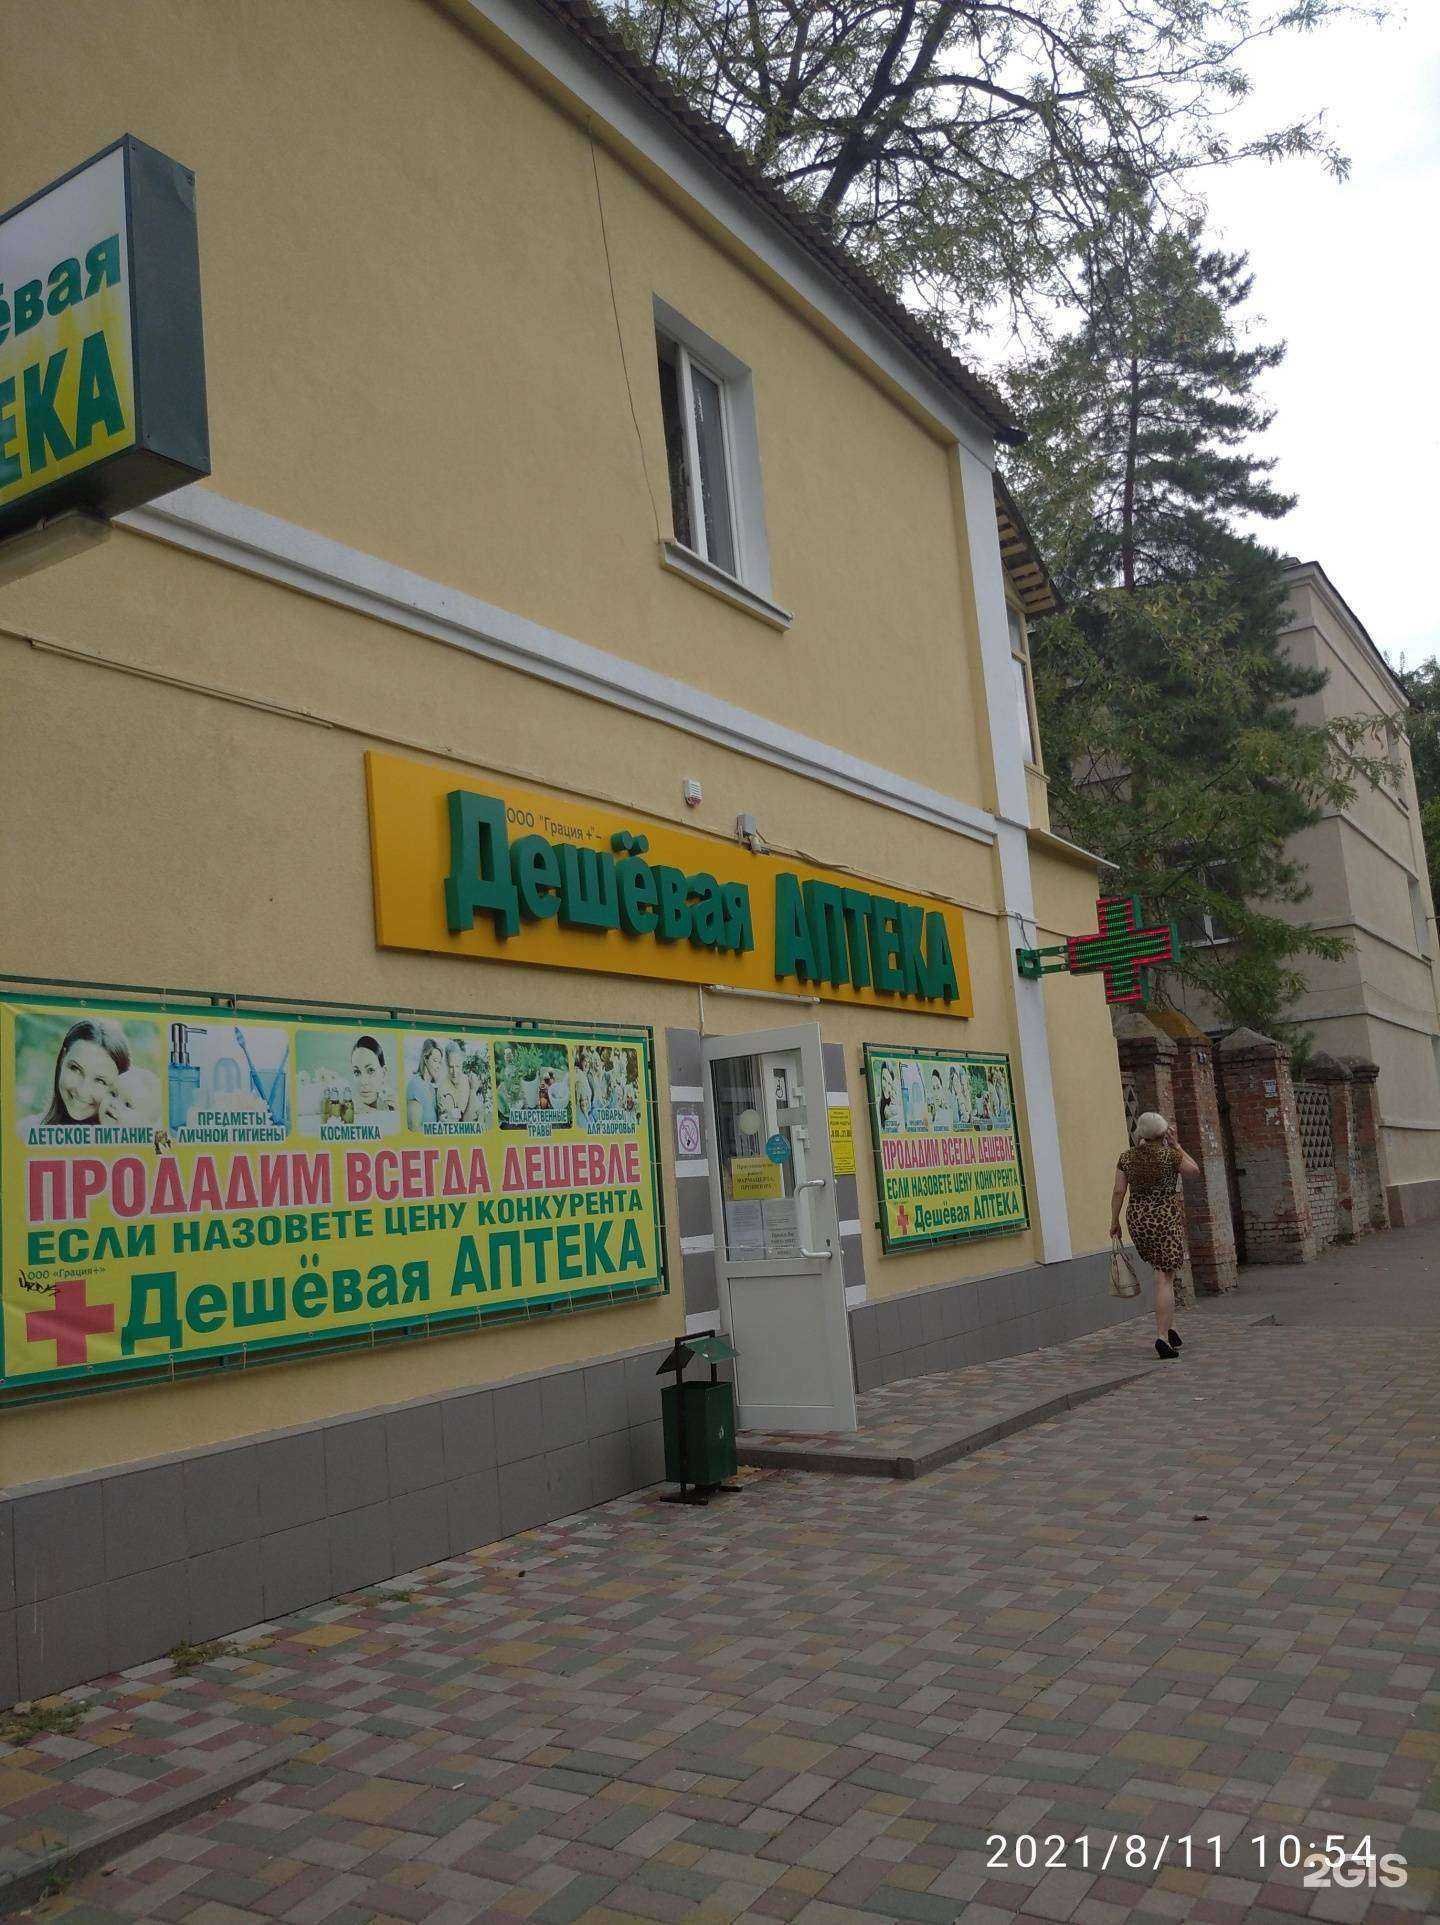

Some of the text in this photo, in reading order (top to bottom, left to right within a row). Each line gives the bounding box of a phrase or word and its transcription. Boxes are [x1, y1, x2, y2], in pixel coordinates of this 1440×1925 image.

[506, 807, 535, 828] ООО
[444, 789, 961, 1001] Дешёвая АПТЕКА
[197, 1111, 267, 1126] ПРЕДМЕТЫ
[597, 1109, 625, 1121] ТОВАРЫ
[28, 1126, 154, 1146] ДЕТСКОЕ ПИТАНИЕ
[178, 1126, 286, 1144] ЛИЧНОЙ ГИГИЕНЫ
[320, 1125, 381, 1141] КОСМЕТИКА
[424, 1122, 482, 1136] МЕДТЕХНИКА
[528, 1124, 552, 1137] ТРАВЫ
[882, 1138, 940, 1170] ПРОДАДИМ
[941, 1137, 977, 1166] ВСЕГДА
[978, 1135, 1016, 1163] ДЕШЕВЛЕ
[28, 1143, 642, 1222] ПРОДАДИМ ВСЕГДА ДЕШЕВЛЕ
[886, 1167, 1019, 1200] ЕСЛИ НАЗОВЕТЕ ЦЕНУ КОНКУРЕНТА
[914, 1190, 1020, 1233] Дешёвая АПТЕКА
[27, 1190, 643, 1265] ЕСЛИ НАЗОВЕТЕ ЦЕНУ КОНКУРЕНТА
[28, 1270, 49, 1280] ООО
[121, 1254, 430, 1356] Дешёвая
[450, 1218, 646, 1297] АПТЕКА
